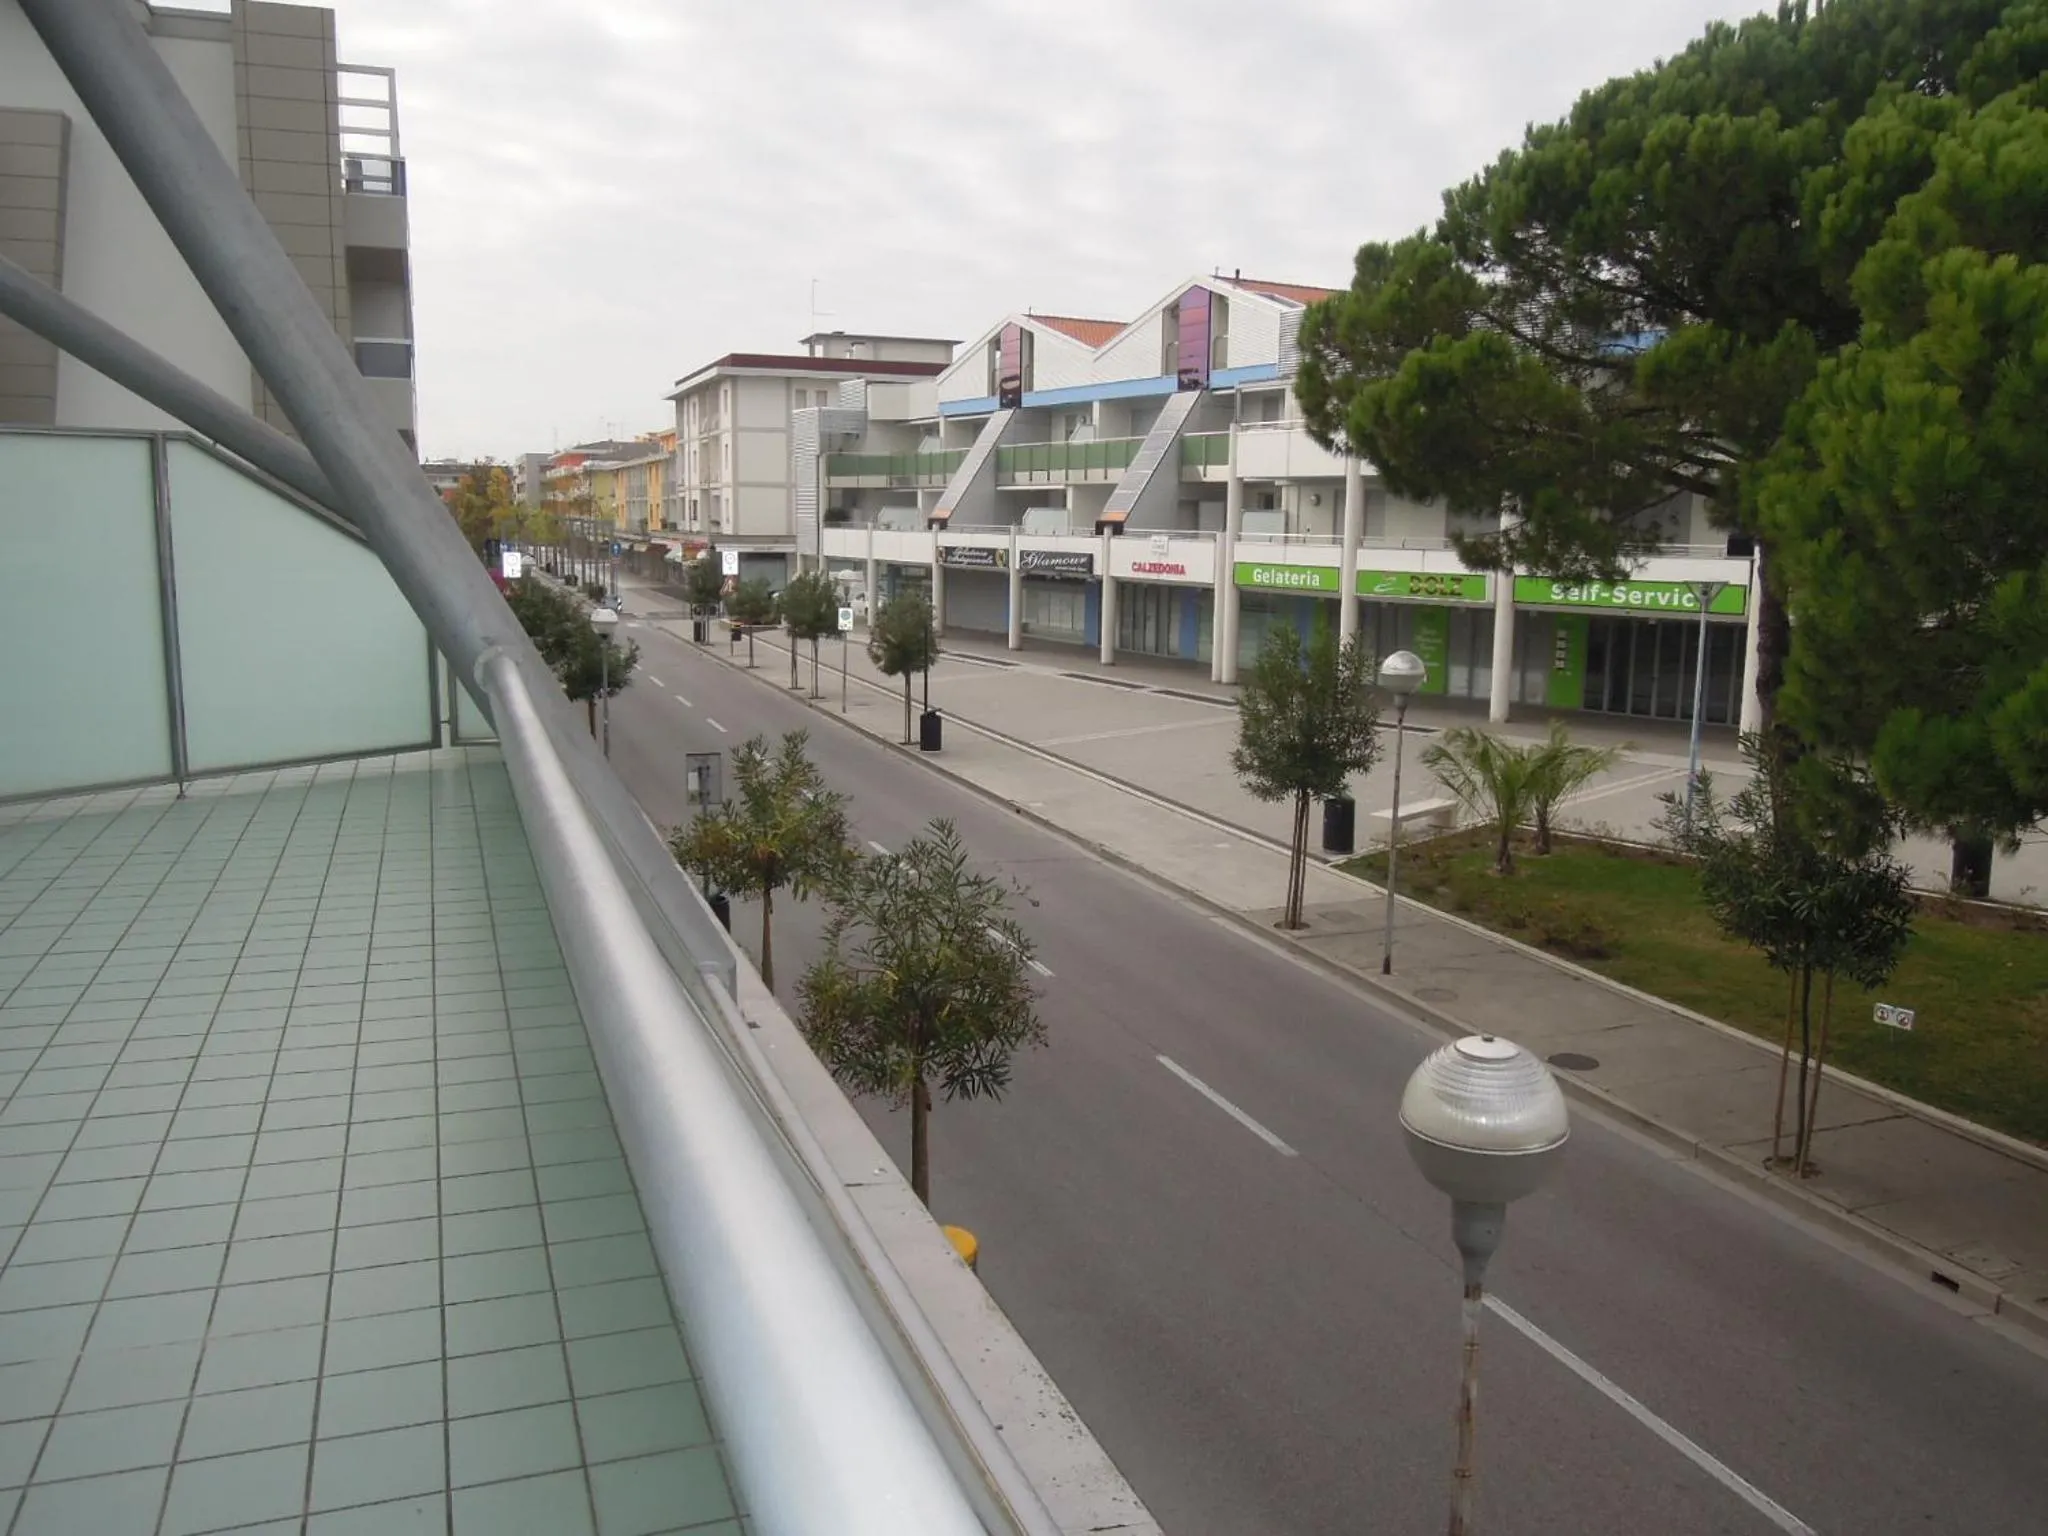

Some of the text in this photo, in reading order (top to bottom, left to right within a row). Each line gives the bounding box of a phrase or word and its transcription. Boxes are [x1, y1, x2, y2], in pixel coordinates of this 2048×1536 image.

[1021, 550, 1088, 569] Glamour
[1132, 561, 1186, 575] CALZEDONIA
[1252, 567, 1320, 587] Gelateria
[1550, 583, 1697, 607] Self-Servic
